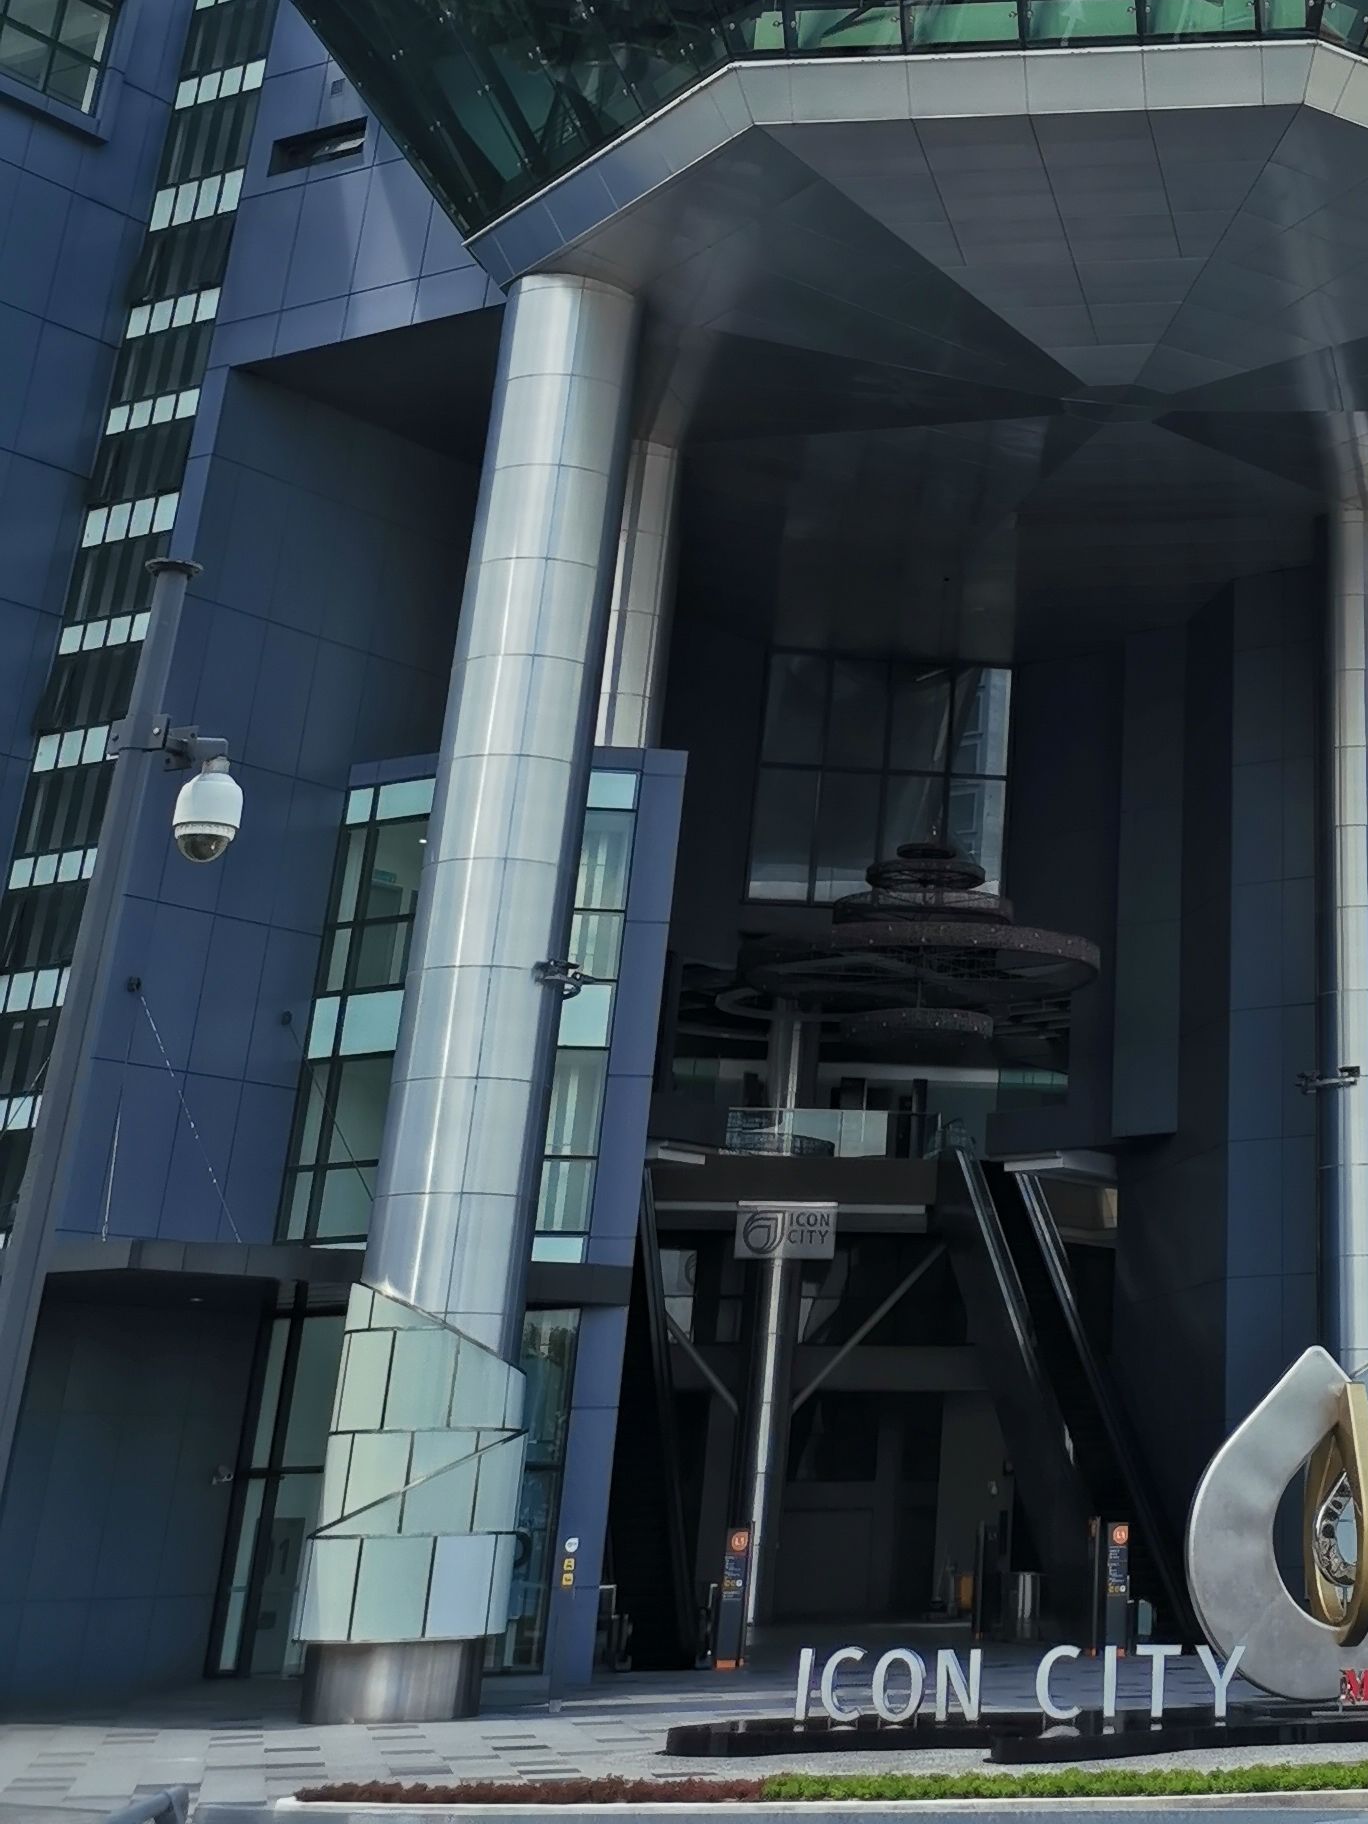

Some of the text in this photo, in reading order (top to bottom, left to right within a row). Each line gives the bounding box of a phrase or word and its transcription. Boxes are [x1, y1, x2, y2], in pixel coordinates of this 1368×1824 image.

[789, 1213, 831, 1228] ICON
[787, 1229, 830, 1245] CITY
[794, 1644, 1247, 1723] ICON CITY
